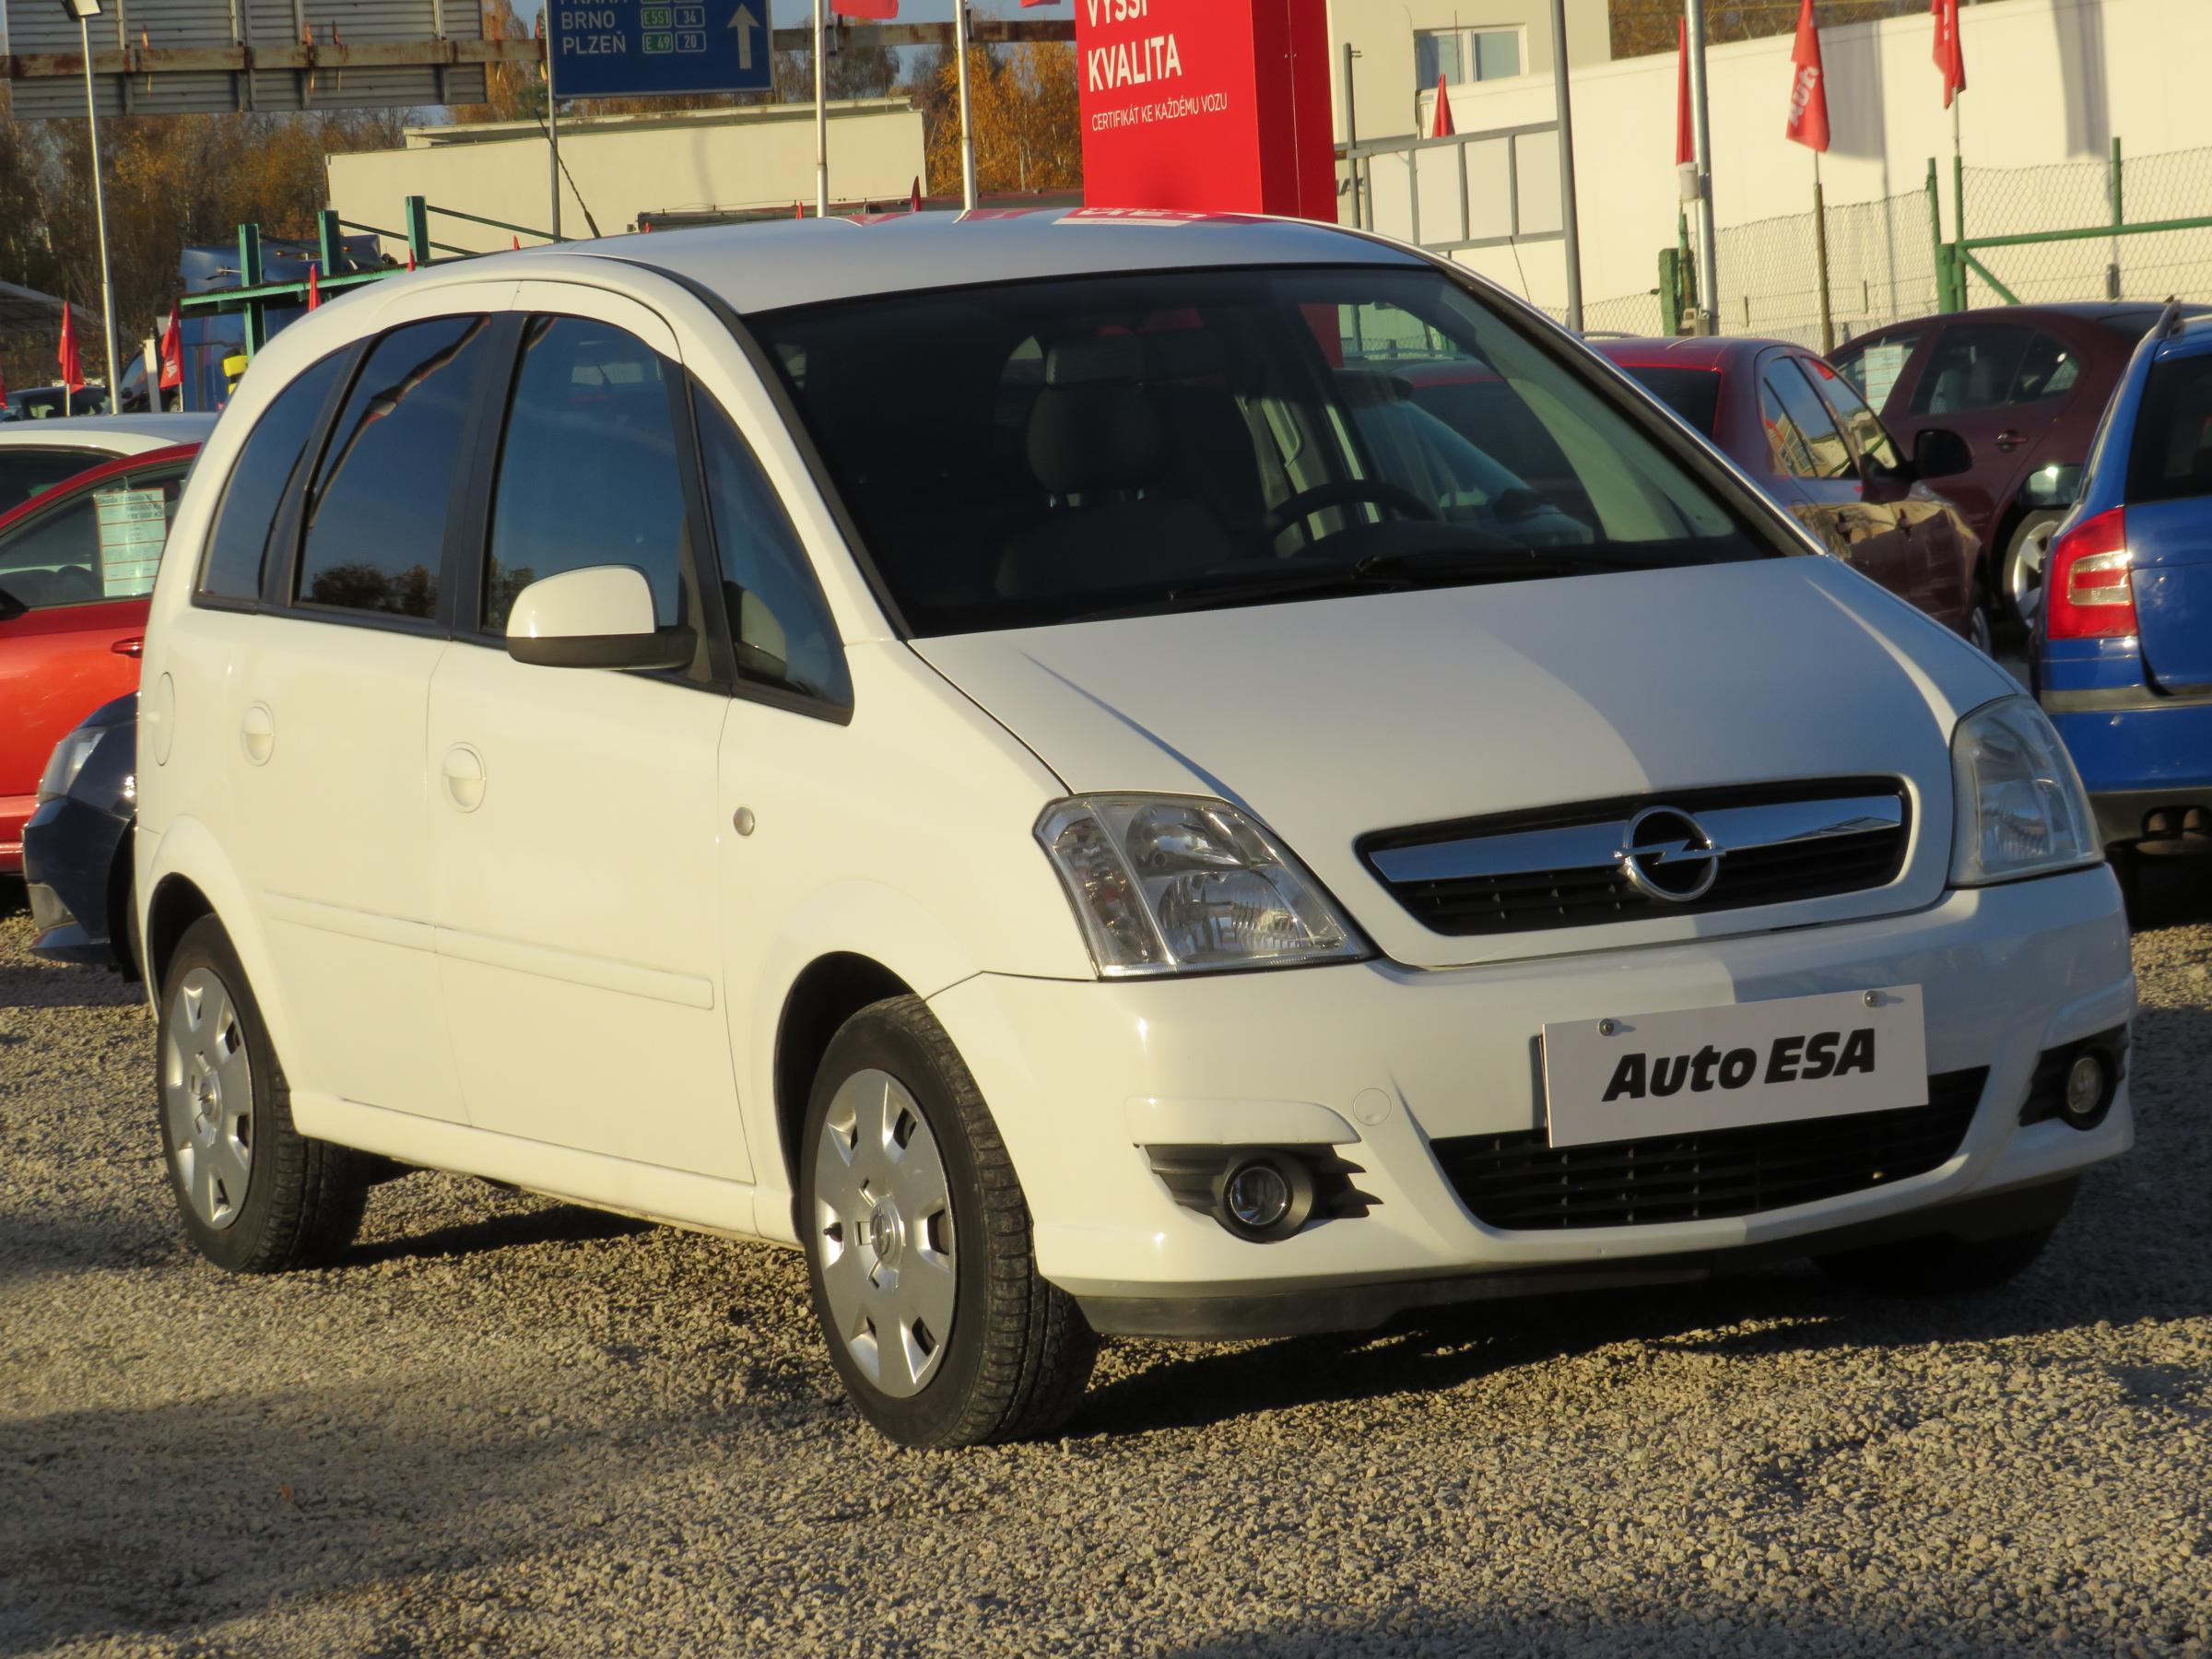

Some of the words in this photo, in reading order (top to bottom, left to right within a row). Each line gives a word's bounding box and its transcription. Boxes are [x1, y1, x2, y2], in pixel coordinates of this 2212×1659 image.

[560, 10, 616, 30] BRNO
[683, 9, 697, 24] 34
[562, 30, 627, 55] PLZEŇ
[684, 34, 698, 49] 20
[1088, 33, 1182, 93] KVALITA
[1091, 103, 1140, 132] CERTIFIKÁT
[1141, 104, 1154, 124] KE
[1154, 95, 1200, 121] KAŽDÉMU
[1200, 92, 1229, 113] VOZU
[1601, 1044, 1758, 1102] Auto
[1763, 1027, 1876, 1085] ESA
